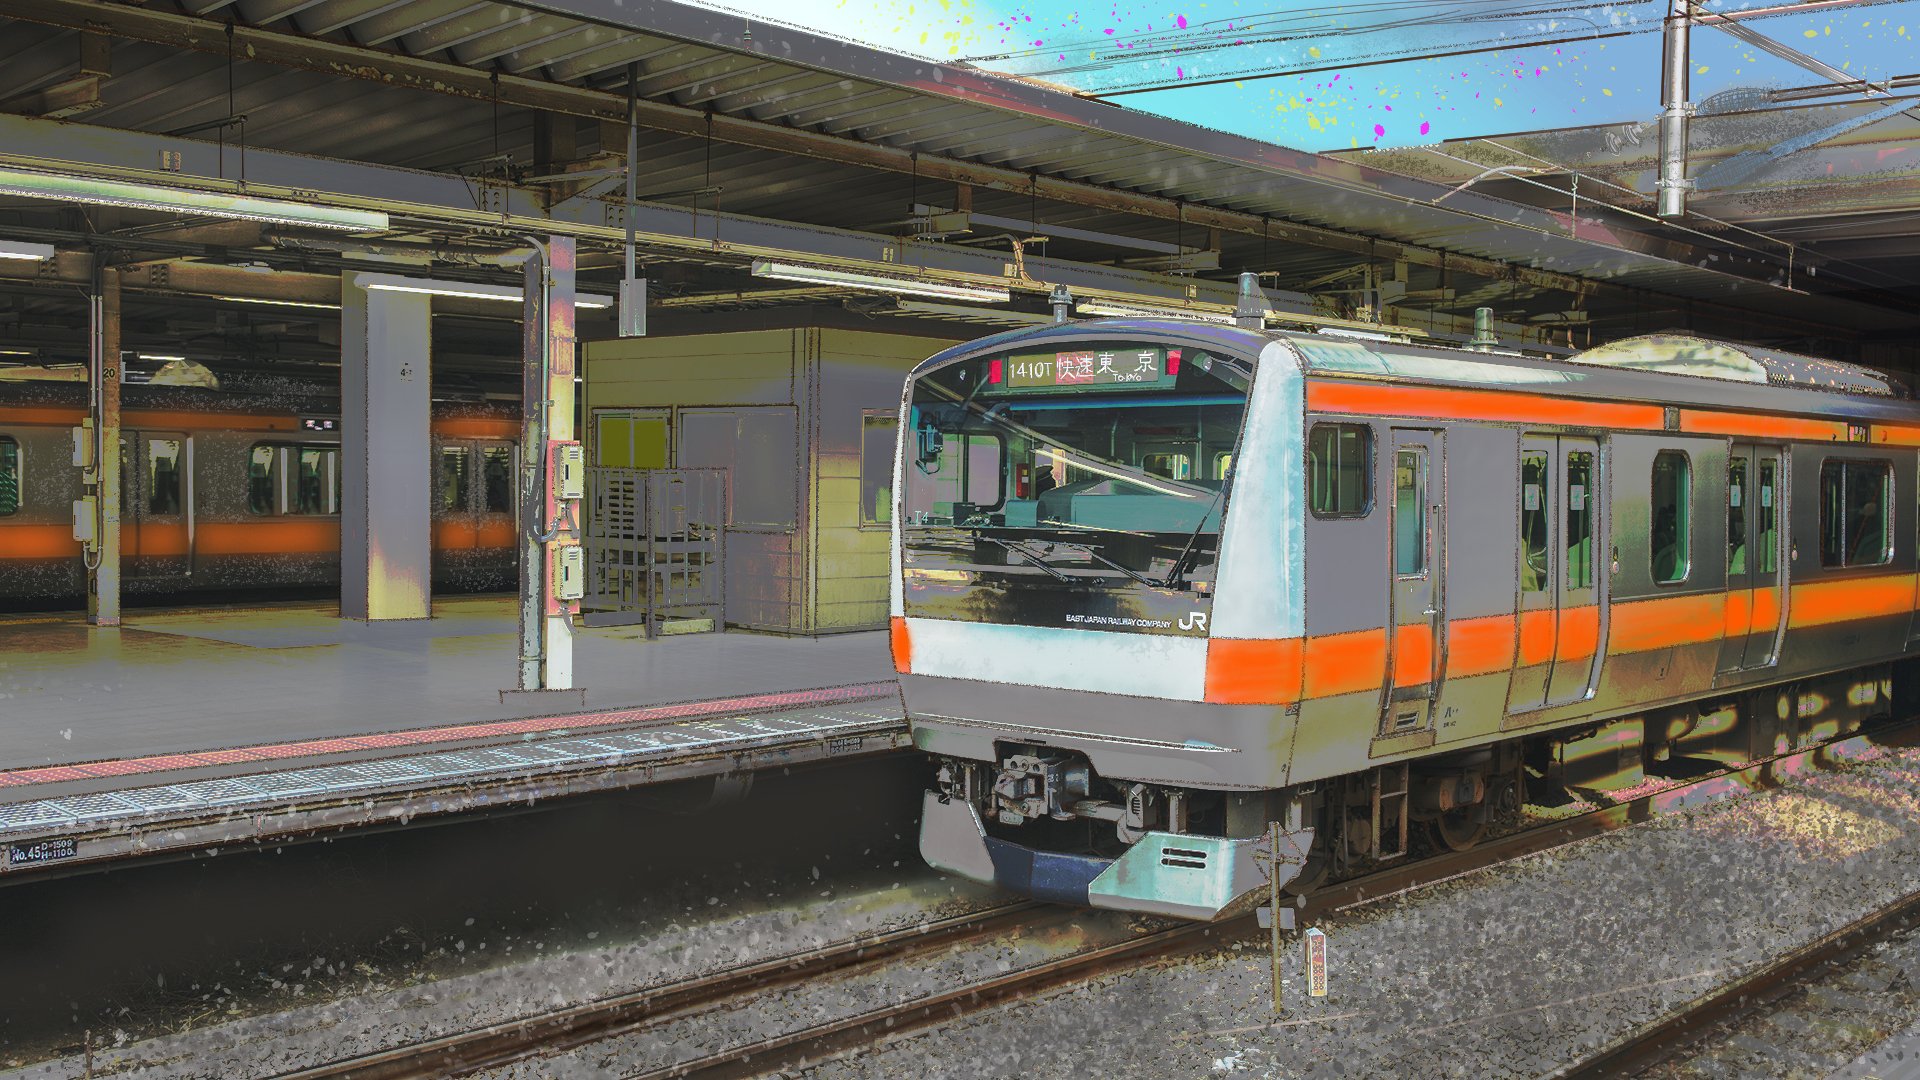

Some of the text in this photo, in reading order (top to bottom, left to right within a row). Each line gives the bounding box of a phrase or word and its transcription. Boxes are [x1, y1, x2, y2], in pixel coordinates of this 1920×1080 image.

[103, 367, 116, 378] 20
[1010, 362, 1053, 379] 1410T
[1056, 355, 1096, 379] 快速
[1065, 614, 1084, 622] EAST
[1084, 615, 1107, 625] JAPAN
[1136, 618, 1172, 629] COMPANY
[1178, 611, 1207, 631] JR
[12, 846, 41, 861] No.45
